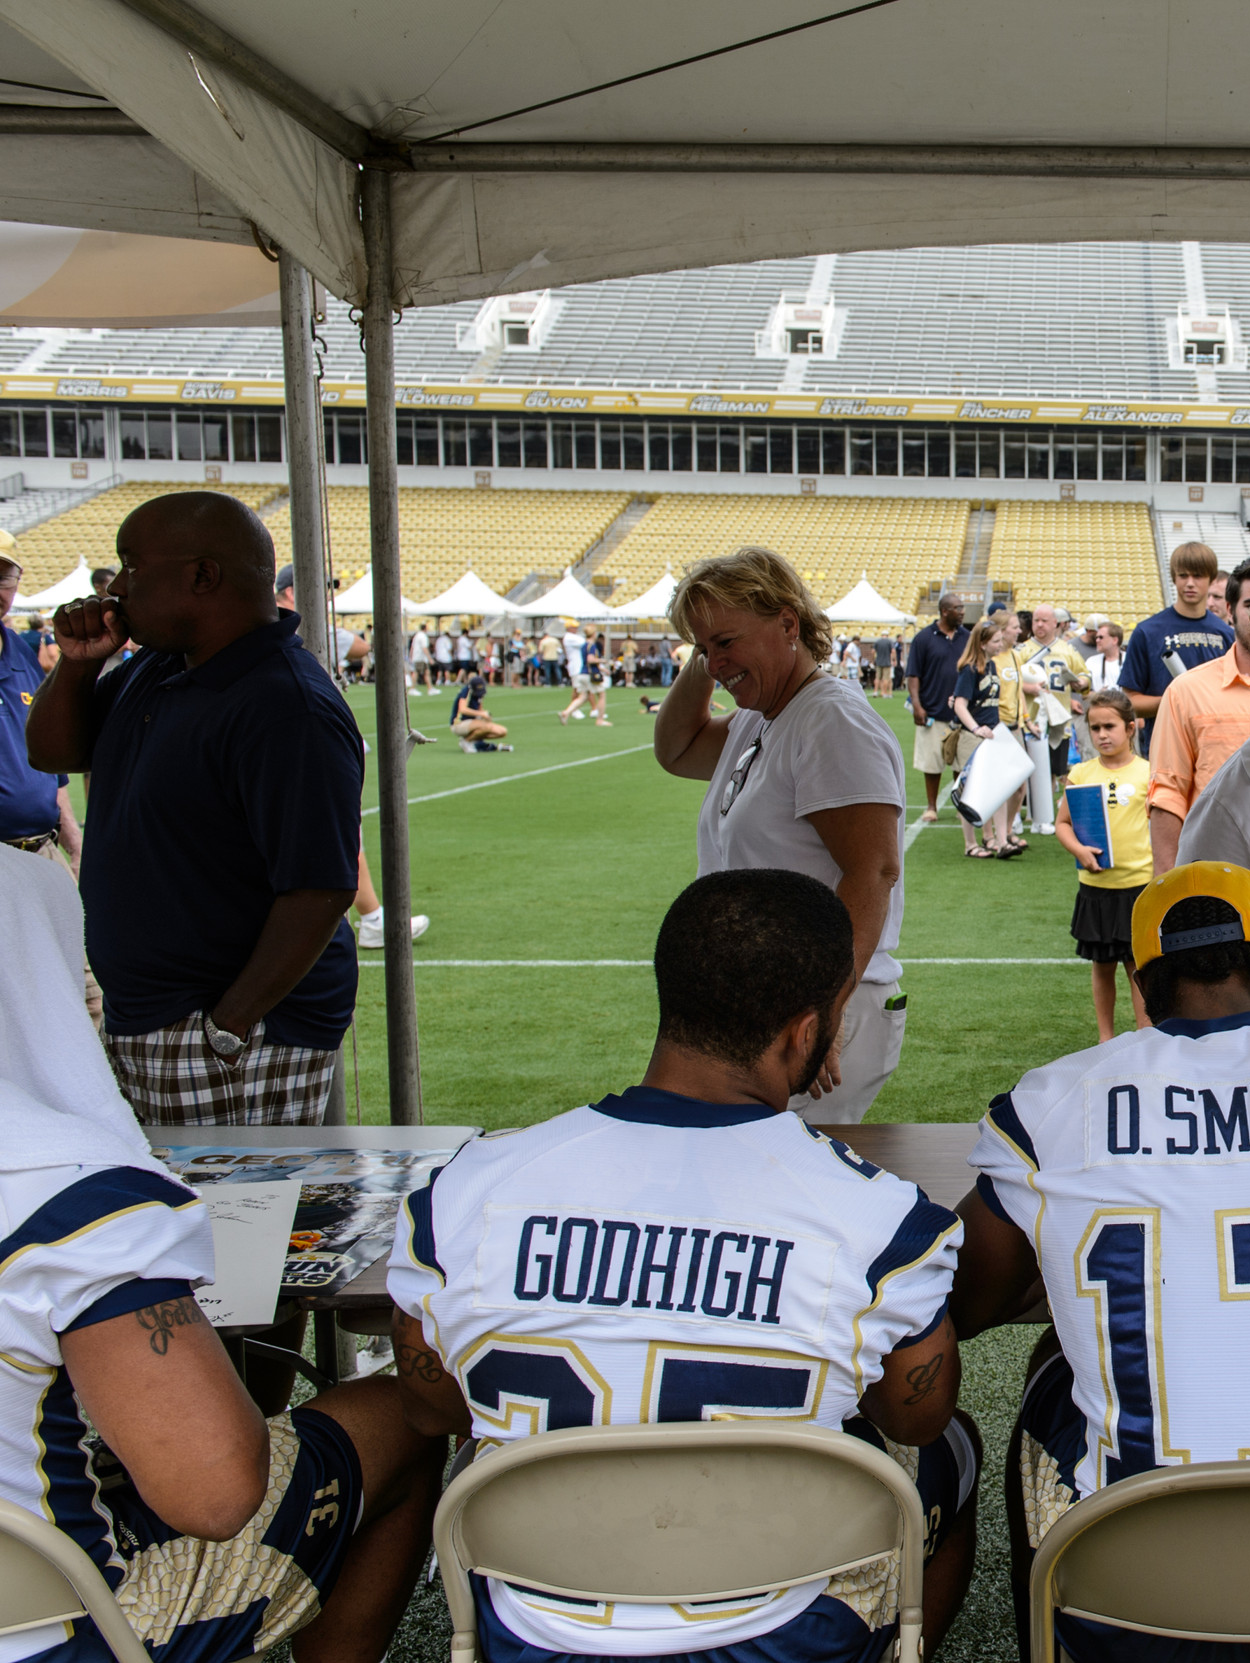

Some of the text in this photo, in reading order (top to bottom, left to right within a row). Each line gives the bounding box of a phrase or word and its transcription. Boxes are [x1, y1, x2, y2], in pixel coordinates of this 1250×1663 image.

[57, 386, 128, 397] MORRIS
[181, 388, 236, 399] DAVIS
[525, 396, 588, 408] GUYON
[689, 401, 769, 413] HEISMAN
[819, 404, 908, 416] STRUPPER
[959, 407, 1032, 419] FINCHER
[1081, 411, 1183, 423] ALEXANDER
[1107, 1084, 1152, 1155] O.
[514, 1215, 795, 1325] GODHIGH
